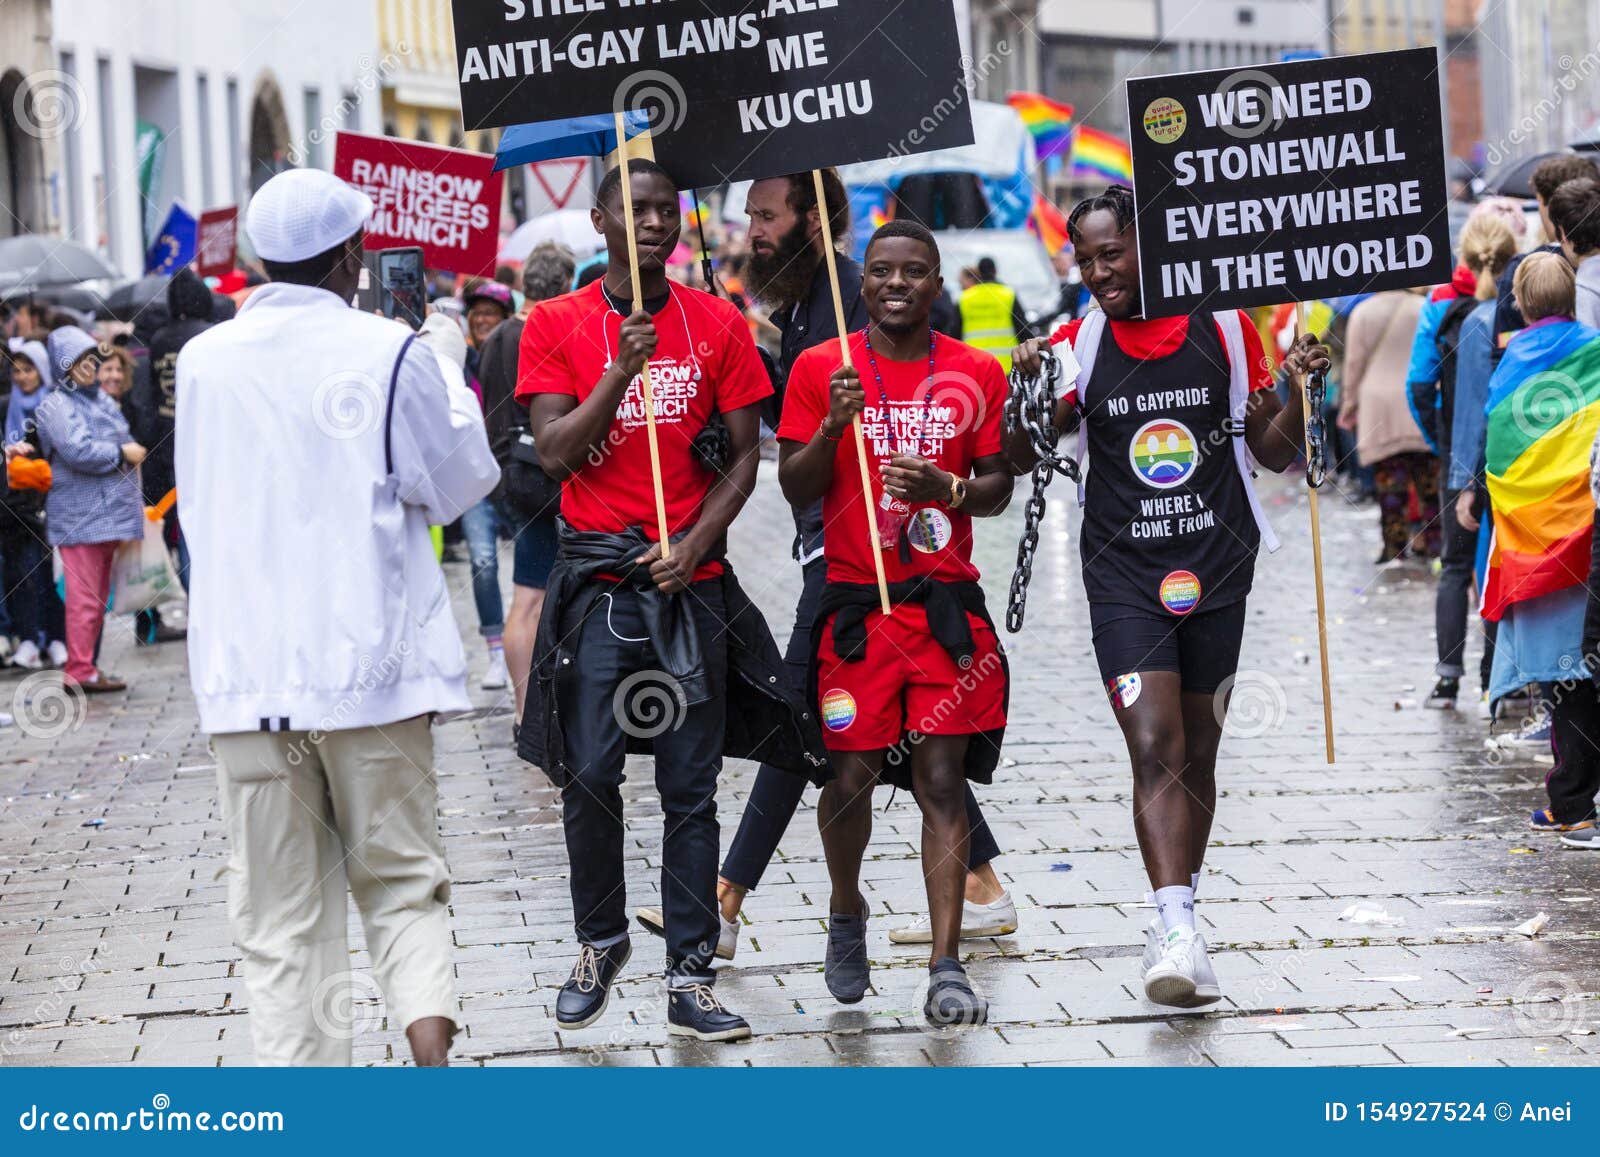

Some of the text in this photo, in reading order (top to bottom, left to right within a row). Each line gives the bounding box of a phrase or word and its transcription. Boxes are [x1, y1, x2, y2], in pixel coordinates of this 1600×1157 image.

[460, 27, 644, 83] ANTI-GAY
[766, 31, 828, 72] ME
[737, 79, 873, 133] KUCHU
[1198, 77, 1372, 128] WE NEED
[352, 159, 483, 202] RAINBOW
[1173, 128, 1406, 186] STONEWALL
[1165, 180, 1422, 242] EVERYWHERE
[1161, 234, 1433, 298] IN THE WORLD
[1107, 388, 1210, 416] NO GAYPRIDE
[1131, 510, 1215, 538] COME FROM
[1140, 495, 1192, 517] WHERE
